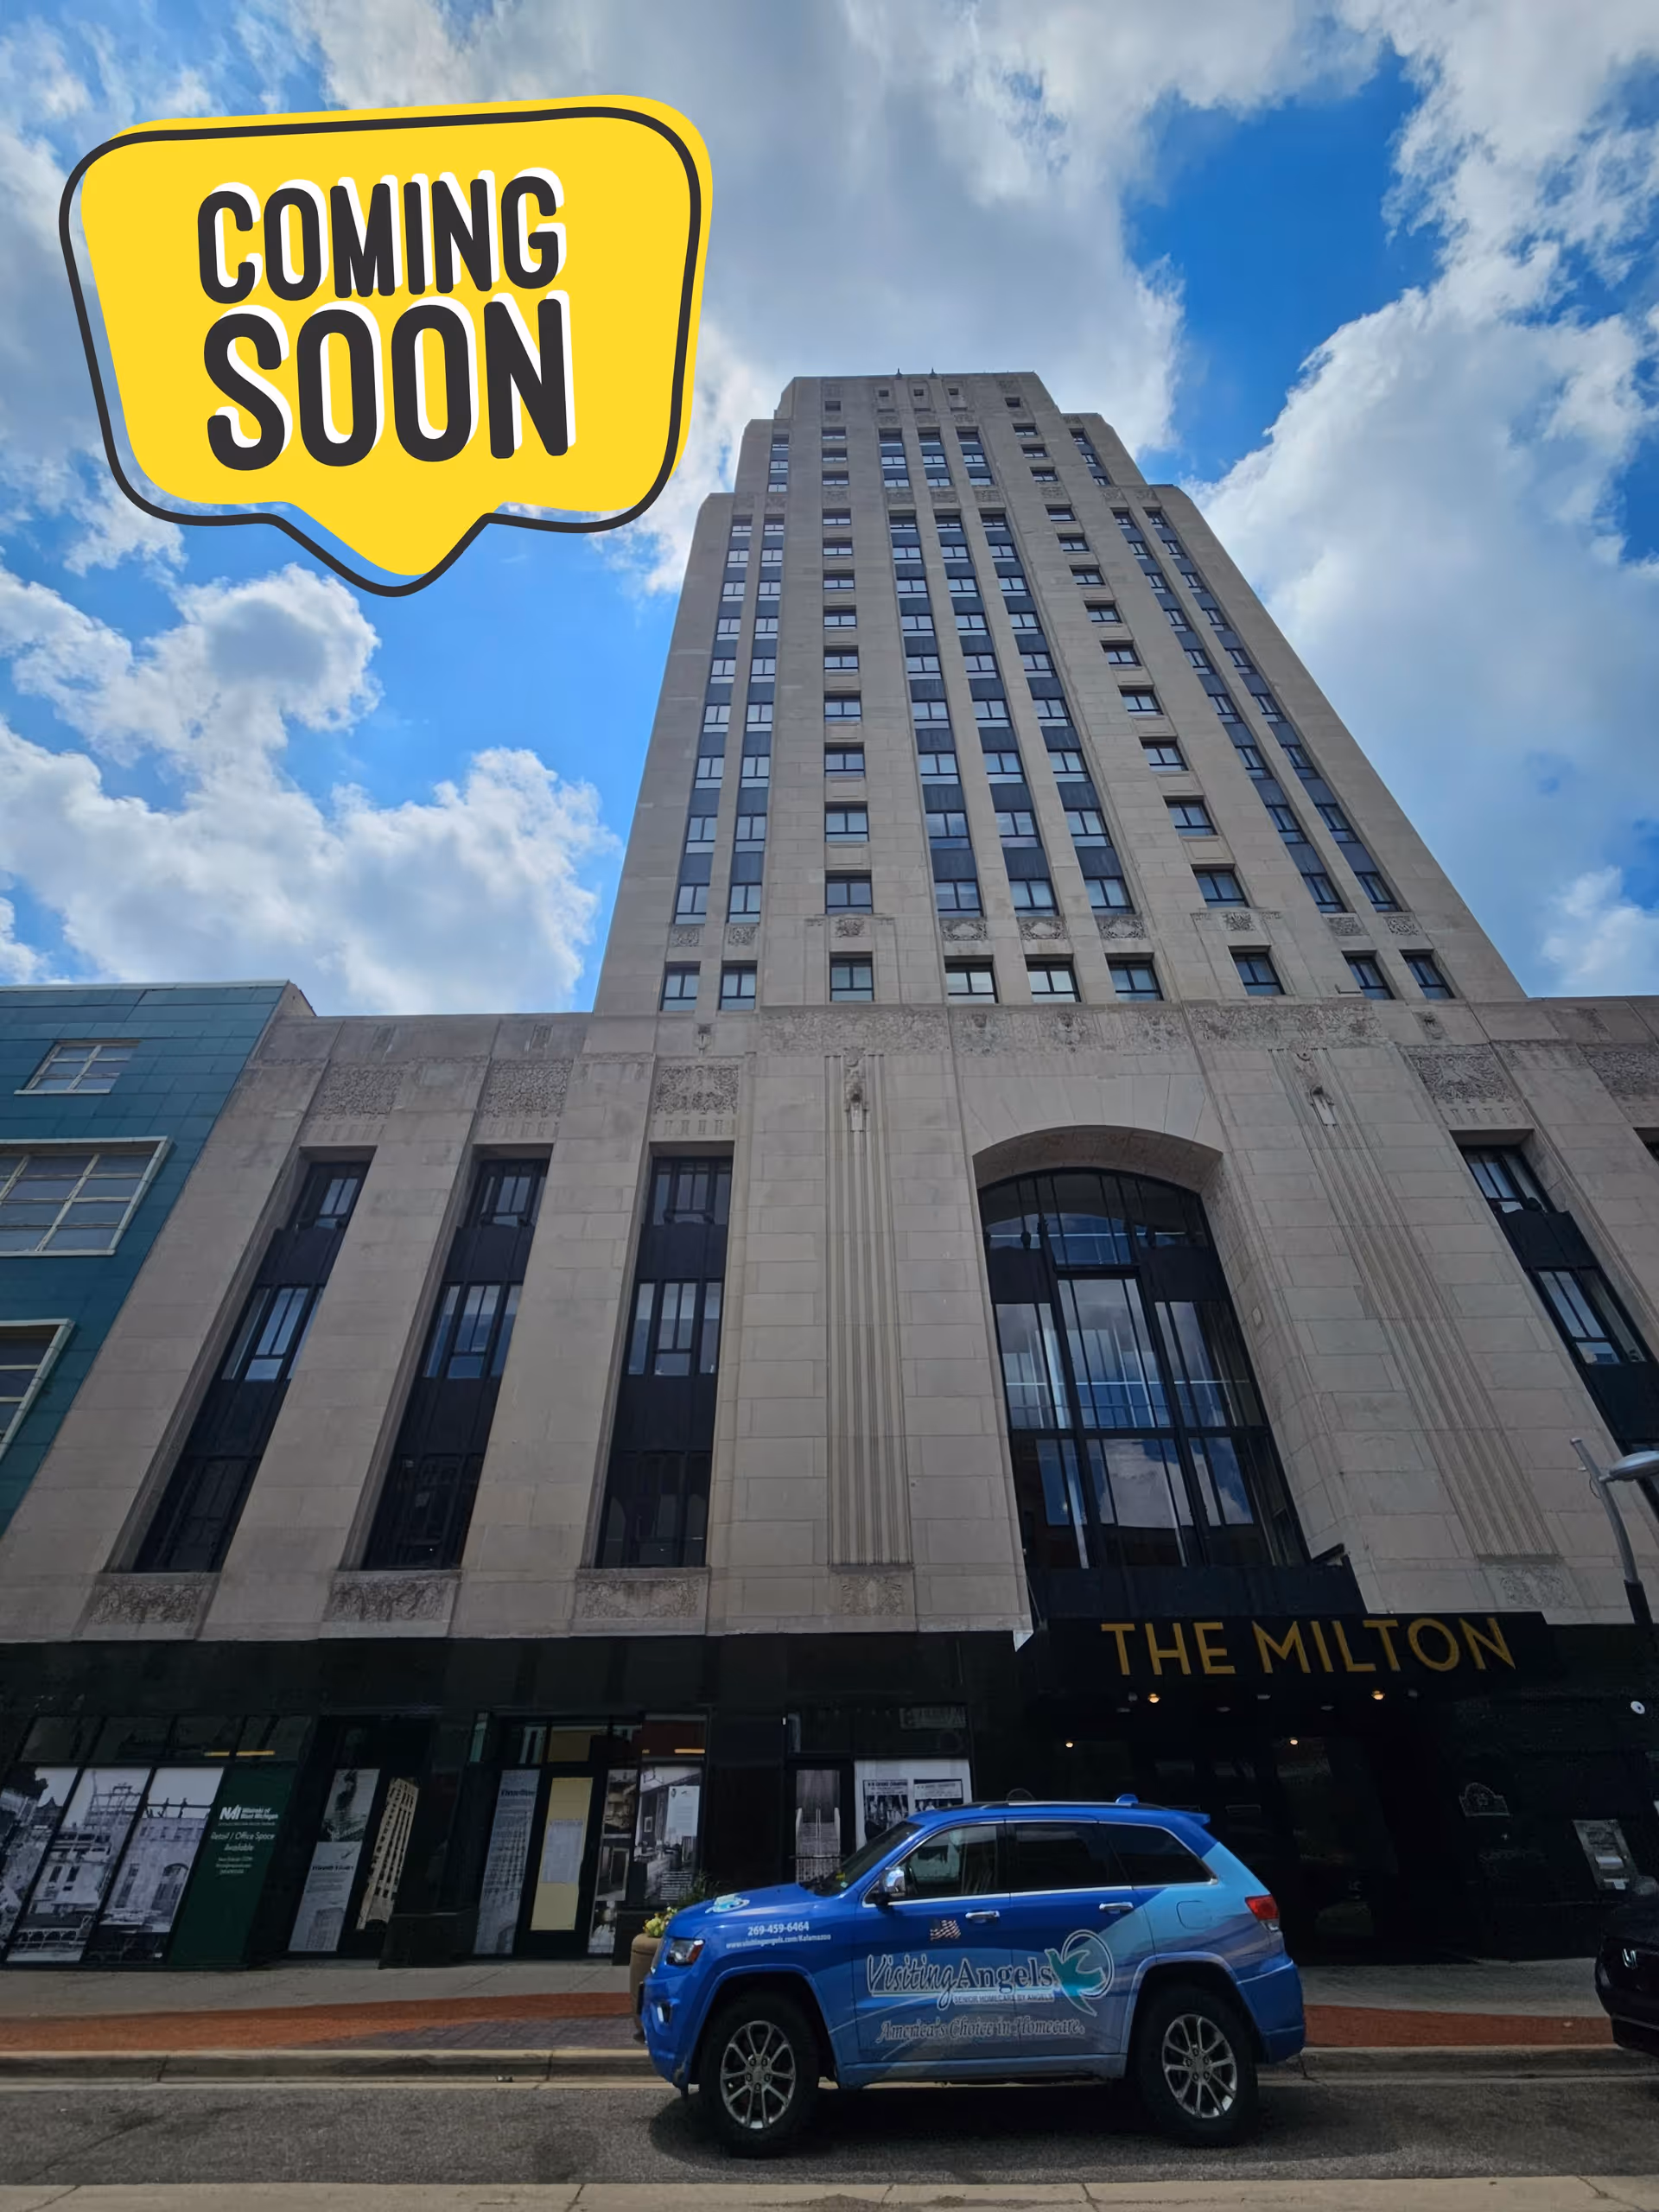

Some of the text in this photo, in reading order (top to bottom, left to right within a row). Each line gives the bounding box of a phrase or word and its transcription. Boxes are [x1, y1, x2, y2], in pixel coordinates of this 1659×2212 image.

[1100, 1617, 1517, 1676] THE MILTON
[235, 1831, 254, 1840] Office
[255, 1831, 276, 1841] Space
[747, 1921, 810, 1936] 269-459-6464
[866, 1954, 1054, 2011] Visiting Angels
[875, 2016, 946, 2044] America's
[949, 2015, 994, 2039] Choice
[996, 2016, 1012, 2036] in
